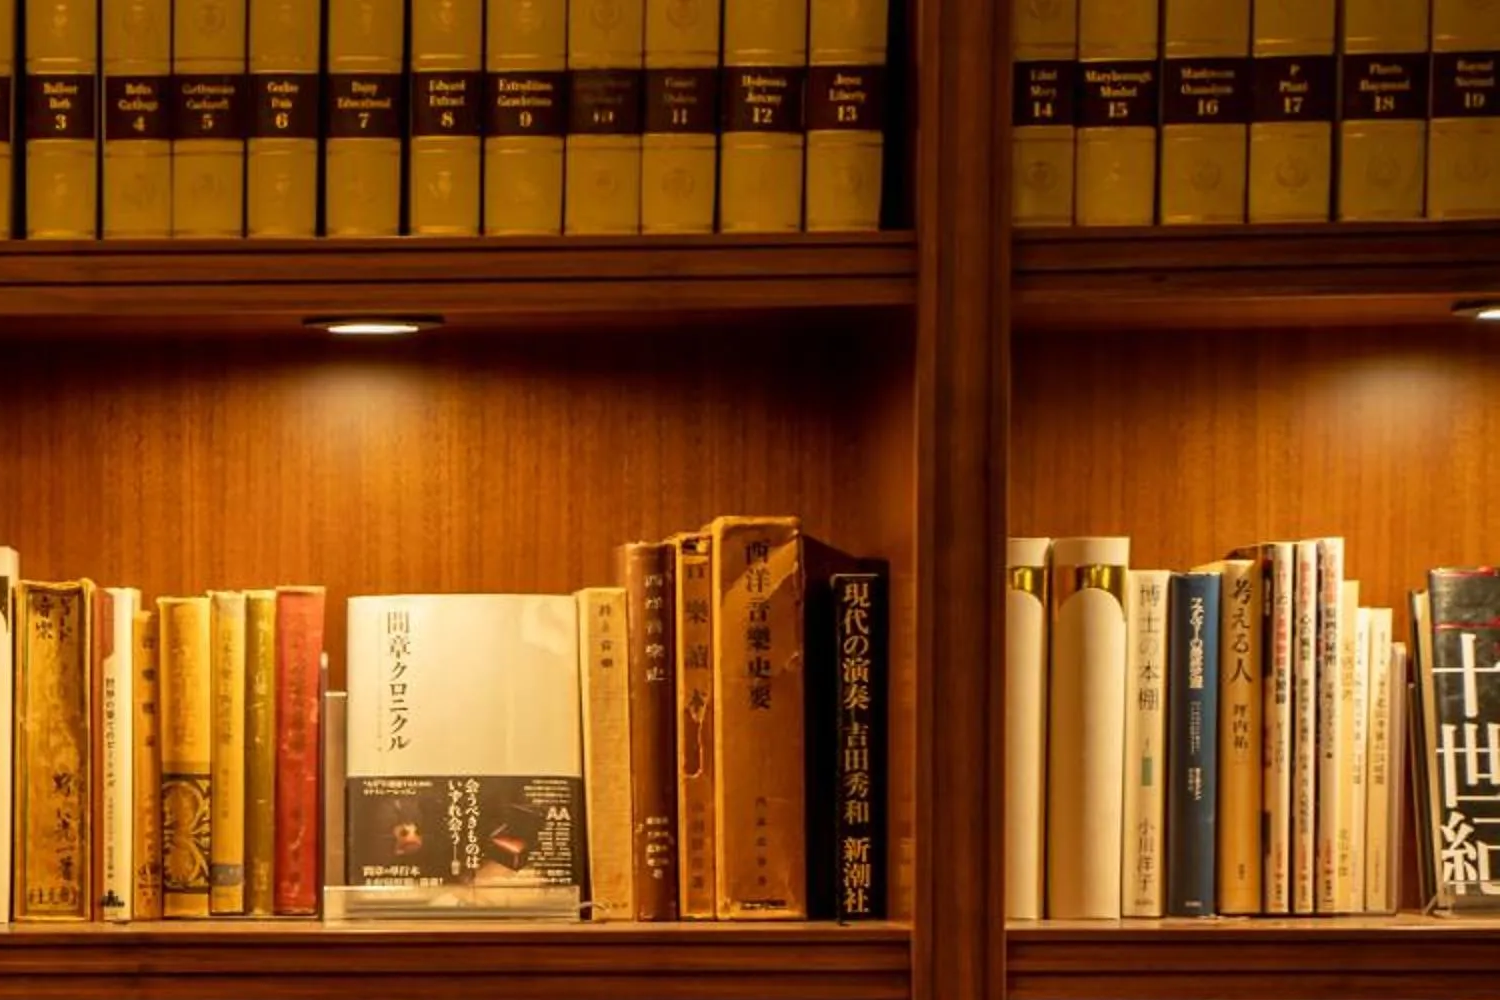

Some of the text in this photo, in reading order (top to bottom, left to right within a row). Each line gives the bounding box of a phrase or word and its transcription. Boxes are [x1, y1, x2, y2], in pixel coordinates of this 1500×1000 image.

[1034, 100, 1055, 119] 14
[1108, 100, 1130, 119] 15
[1197, 98, 1220, 117] 16
[1283, 96, 1305, 114] 17
[1374, 95, 1396, 113] 18
[1464, 91, 1486, 109] 19
[54, 113, 68, 131] 3
[201, 112, 215, 131] 5
[275, 111, 289, 130] 6
[357, 111, 372, 130] 7
[440, 111, 455, 129] 8
[672, 107, 689, 126] 11
[751, 106, 774, 125] 12
[837, 103, 858, 123] 13
[132, 115, 147, 132] 4
[1229, 577, 1253, 685] 考える人
[1136, 583, 1160, 712] 博士の本棚
[843, 581, 871, 915] 現代の演奏 吉田秀和 新潮社
[546, 806, 571, 821] AA
